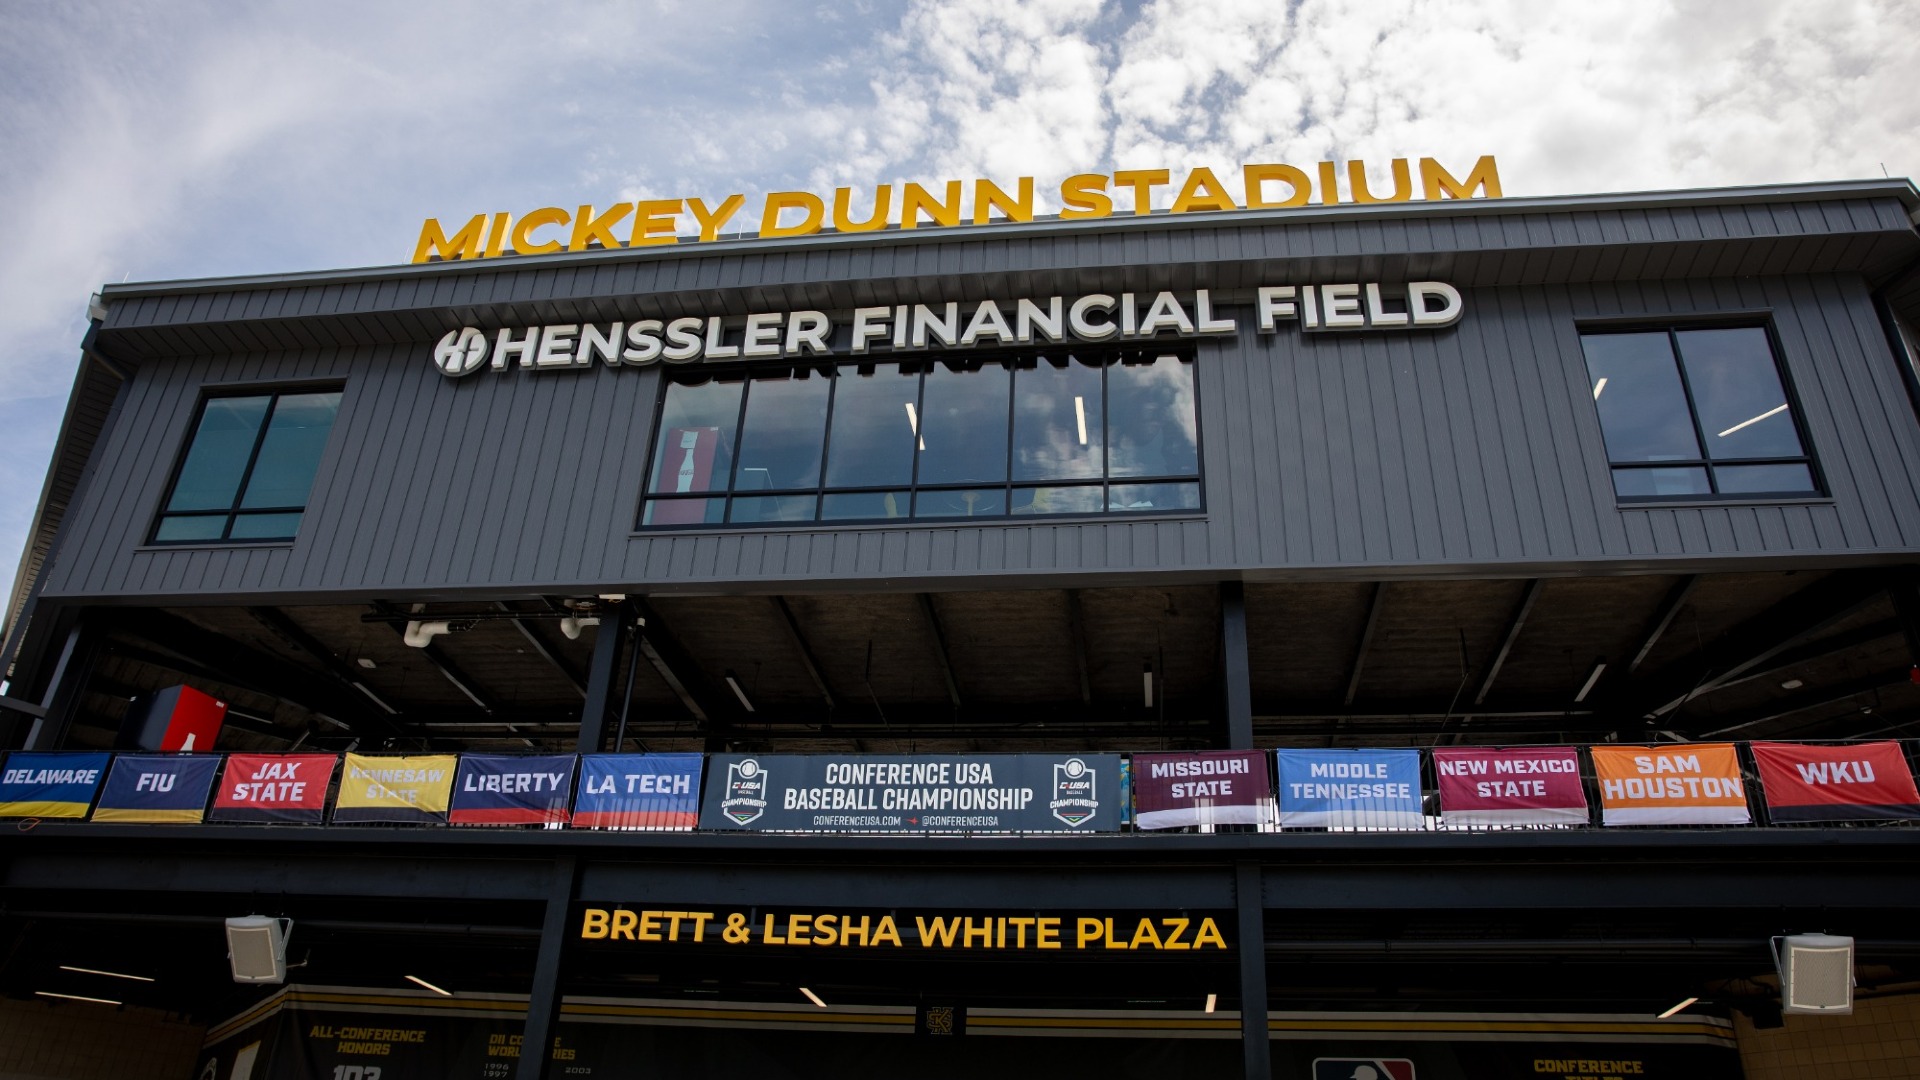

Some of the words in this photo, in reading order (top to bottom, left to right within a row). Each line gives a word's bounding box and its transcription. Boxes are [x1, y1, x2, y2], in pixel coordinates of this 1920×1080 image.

[411, 194, 746, 263] MICKEY
[759, 177, 1034, 239] DUNN
[1058, 155, 1502, 220] STADIUM
[491, 310, 833, 370] HENSSLER
[852, 289, 1236, 351] FINANCIAL
[1258, 281, 1462, 329] FIELD
[251, 762, 301, 780] JAX
[1151, 759, 1249, 778] MISSOURI
[1310, 763, 1388, 779] MIDDLE
[1439, 760, 1488, 776] NEW
[1495, 759, 1575, 774] MEXICO
[1633, 754, 1701, 774] SAM
[1796, 760, 1875, 785] WKU
[2, 769, 99, 784] DELAWARE
[136, 773, 176, 792] FIU
[350, 766, 446, 783] KENNESAW
[464, 772, 564, 793] LIBERTY
[825, 763, 950, 785] CONFERENCE
[955, 763, 993, 785] USA
[232, 782, 306, 802] STATE
[586, 775, 616, 794] LA
[624, 774, 690, 794] TECH
[1171, 780, 1233, 798] STATE
[1290, 783, 1411, 799] TENNESSEE
[1476, 780, 1546, 798] STATE
[1603, 777, 1743, 800] HOUSTON
[366, 784, 419, 804] STATE
[721, 797, 768, 808] CHAMPIONSHIP
[783, 788, 878, 810] BASEBALL
[882, 788, 1033, 810] CHAMPIONSHIP
[1049, 798, 1099, 809] CHAMPIONSHIP
[813, 815, 901, 826] CONFERENCEUSA.COM
[922, 815, 999, 827] @CONFERENCEUSA
[581, 909, 713, 942] BRETT
[722, 912, 750, 944] &
[763, 913, 902, 948] LESHA
[915, 916, 1061, 949] WHITE
[1076, 917, 1227, 949] PLAZA
[309, 1025, 427, 1043] ALL-CONFERENCE
[337, 1042, 391, 1056] HONORS
[488, 1045, 522, 1058] WORL
[483, 1070, 508, 1078] 1997
[485, 1063, 509, 1071] 1996
[565, 1066, 592, 1075] 2003
[1533, 1058, 1644, 1074] CONFERENCE
